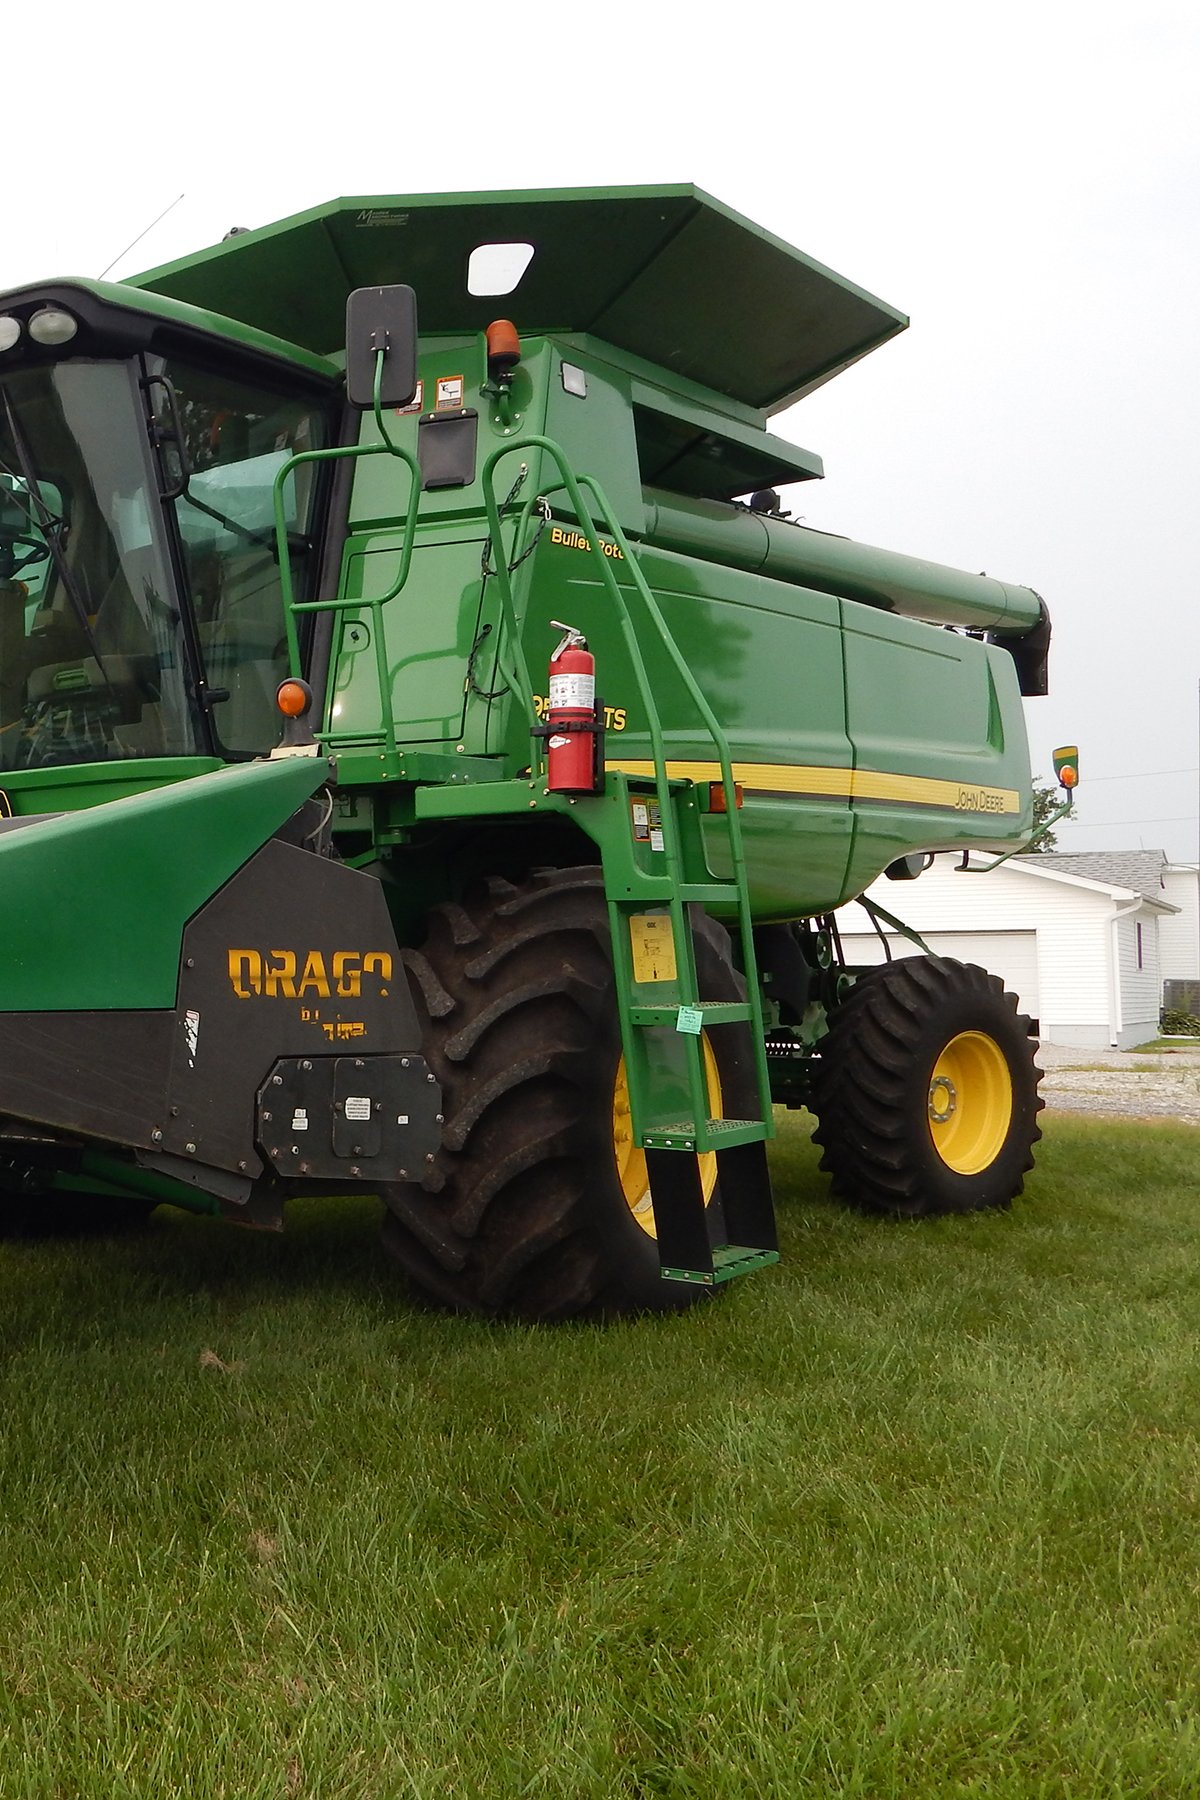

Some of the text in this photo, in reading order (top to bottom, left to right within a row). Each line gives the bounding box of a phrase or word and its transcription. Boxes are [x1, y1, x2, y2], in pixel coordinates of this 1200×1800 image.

[551, 527, 592, 552] Bullet
[955, 787, 1004, 812] JOHN DEERE
